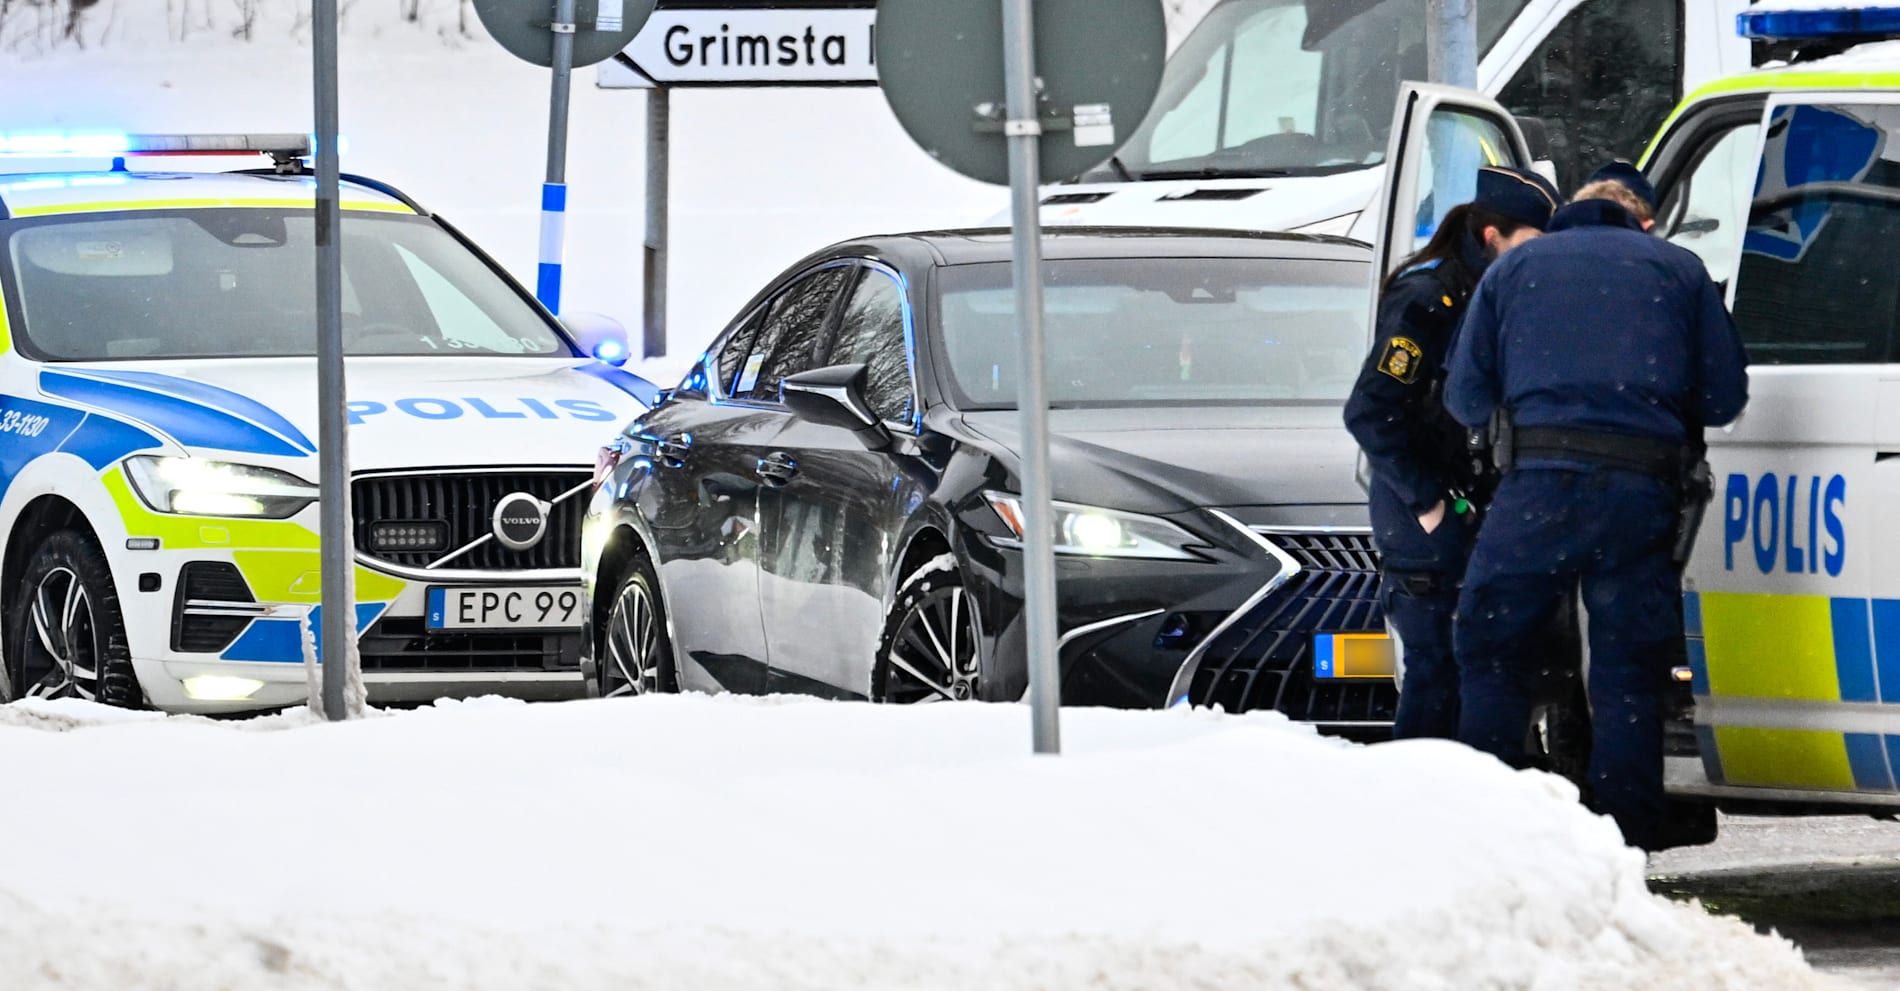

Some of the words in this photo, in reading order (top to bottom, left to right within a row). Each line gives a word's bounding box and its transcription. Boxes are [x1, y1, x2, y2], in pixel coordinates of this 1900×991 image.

[664, 24, 846, 66] Grimsta
[348, 397, 617, 425] POLIS
[503, 517, 540, 525] VOLVO
[1724, 472, 1846, 577] POLIS
[433, 612, 440, 621] S
[459, 591, 522, 623] EPC
[1320, 660, 1329, 670] S
